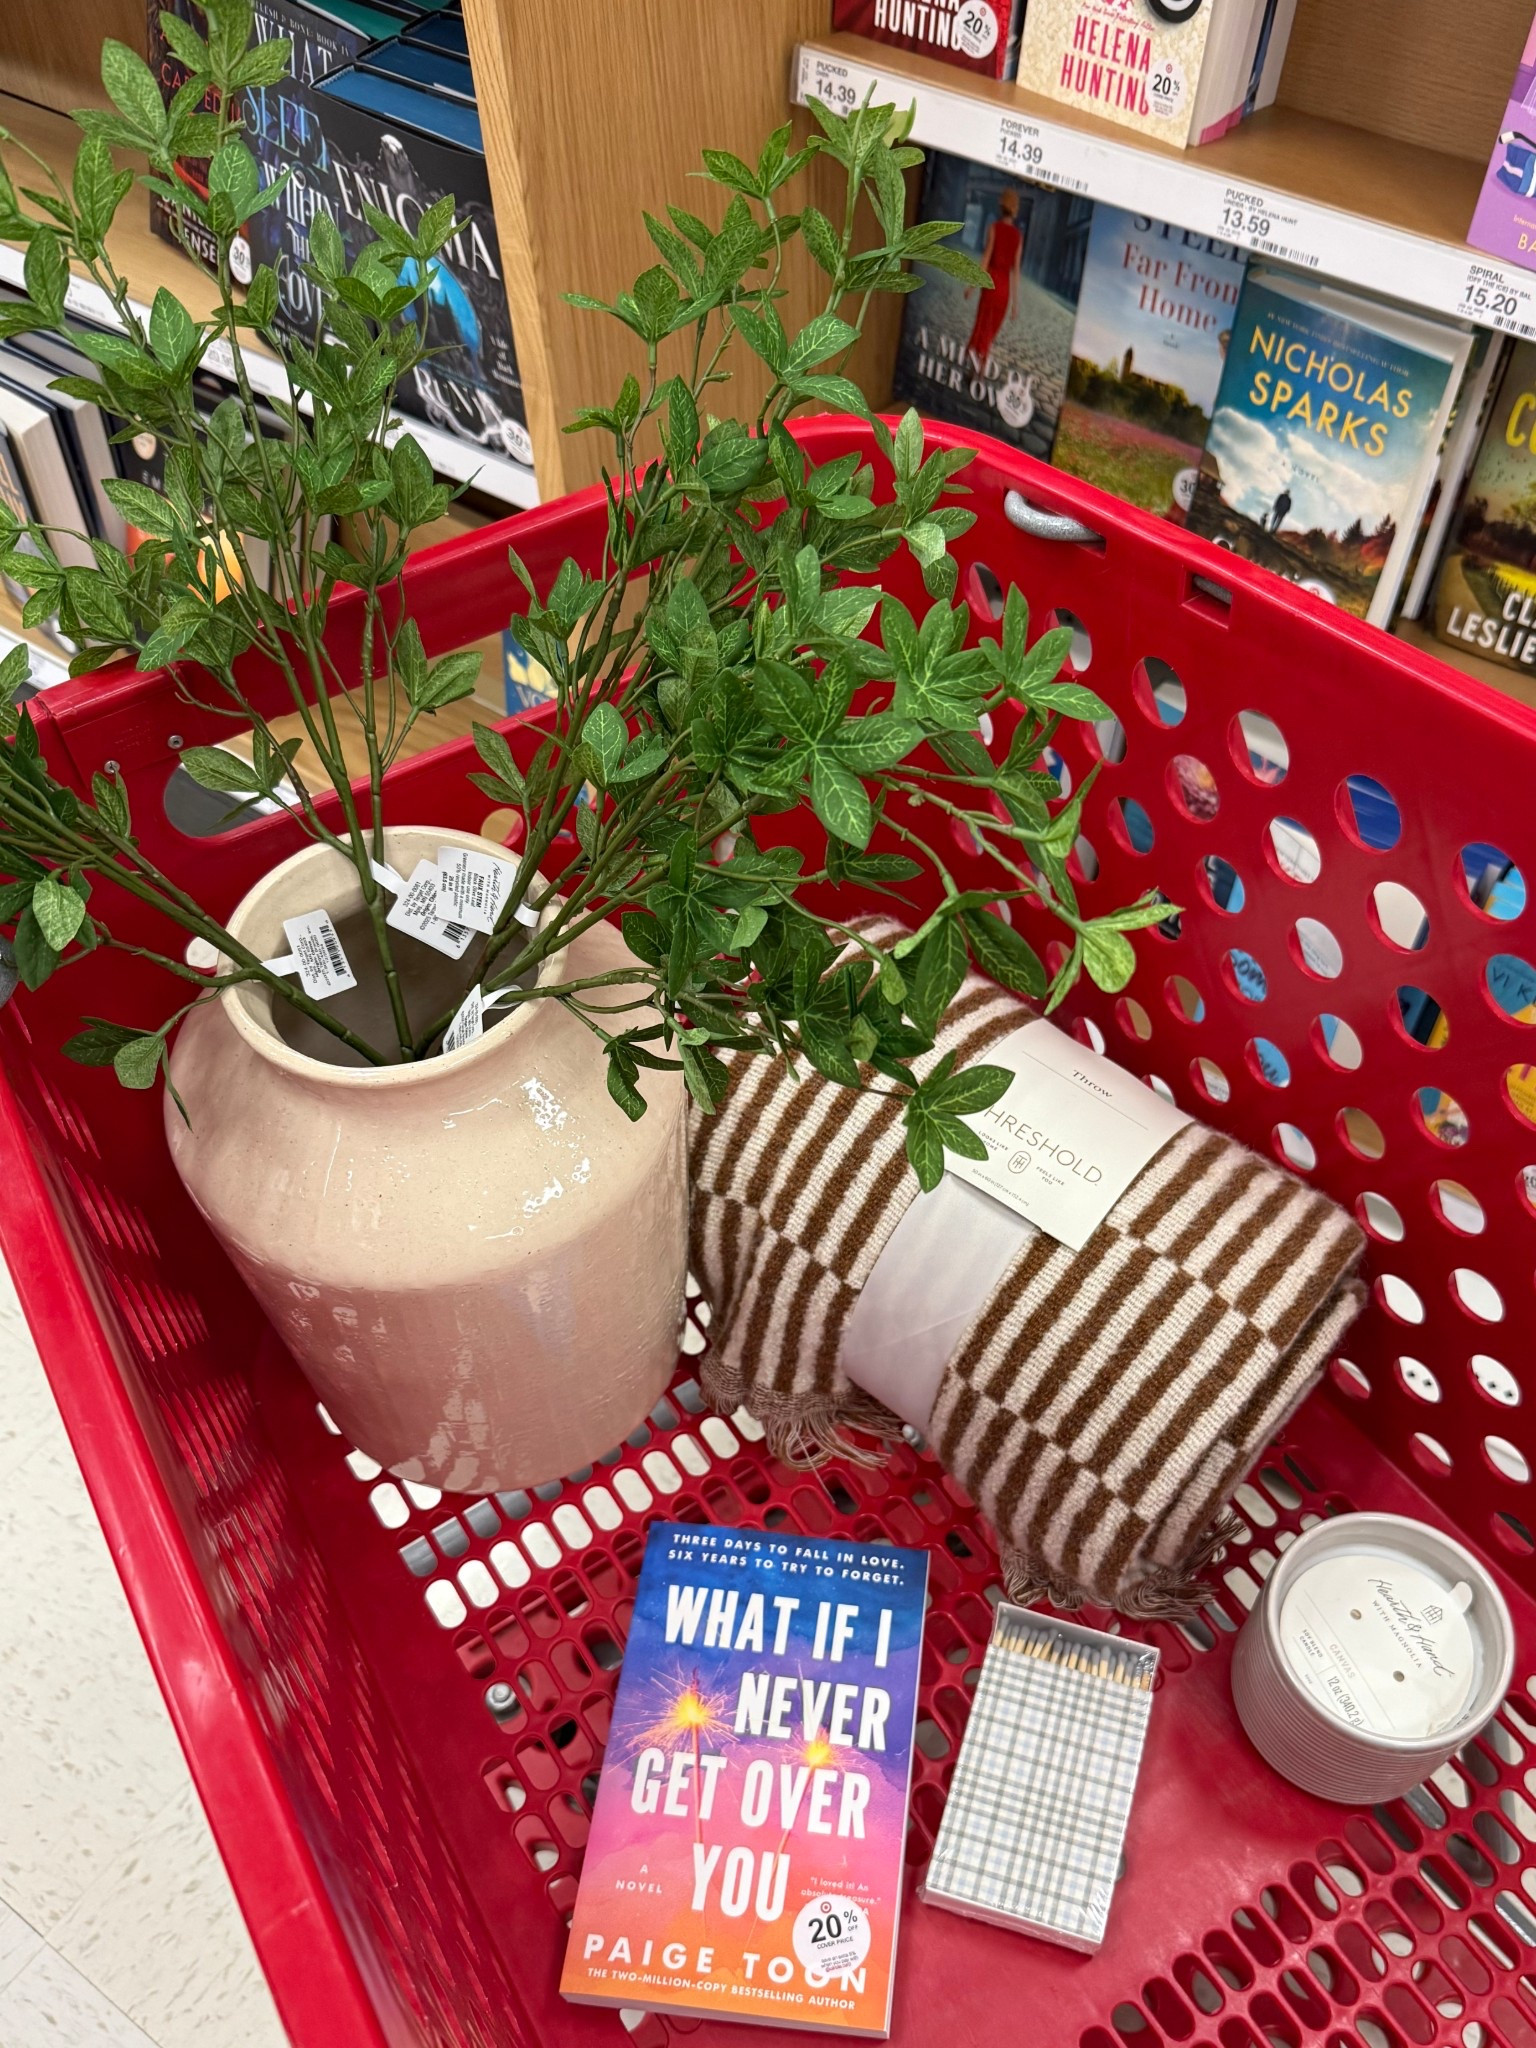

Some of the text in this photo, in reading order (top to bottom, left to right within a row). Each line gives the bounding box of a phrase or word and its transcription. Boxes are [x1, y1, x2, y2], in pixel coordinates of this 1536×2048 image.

[1072, 14, 1151, 74] HELENA
[816, 60, 848, 78] PUCKED
[816, 79, 856, 105] 14.39
[1001, 118, 1040, 138] FOREVER
[1000, 136, 1043, 164] 14.39
[1225, 189, 1264, 208] PUCKED
[1222, 207, 1271, 236] 13.59
[184, 227, 217, 264] ENSE
[1122, 243, 1168, 281] Far
[1469, 265, 1505, 285] SPIRAL
[1138, 284, 1217, 333] Home
[1464, 284, 1518, 316] 15.20
[918, 354, 962, 393] HER
[1249, 324, 1413, 418] NICHOLAS
[1249, 371, 1388, 458] SPARKS
[1447, 605, 1536, 664] LESLIE
[475, 891, 483, 907] STEM
[1072, 1068, 1113, 1099] Throw
[983, 1105, 1103, 1185] HRESHOLD
[668, 1549, 905, 1586] SIX YEARS TO TRY TO FORGET.
[673, 1533, 905, 1570] THREE DAYS TO FALL IN LOVE.
[665, 1584, 893, 1668] WHAT IF I
[1367, 1578, 1453, 1677] Hearth & Hand
[1371, 1600, 1423, 1669] WITH MAGNOLIA
[1329, 1643, 1356, 1679] CANVAS
[1327, 1675, 1338, 1689] 12
[1332, 1685, 1343, 1696] oz
[734, 1672, 892, 1751] NEVER
[1338, 1693, 1360, 1719] (340.2
[631, 1747, 871, 1839] GET OVER
[615, 1880, 663, 1894] NOVEL
[639, 1864, 648, 1874] A
[691, 1842, 791, 1922] YOU
[820, 1877, 843, 1889] loved
[857, 1883, 869, 1892] An
[583, 1933, 715, 1975] PAIGE
[817, 1936, 854, 1950] COVER PRICE
[587, 1967, 856, 2010] THE TWO-MILLION-COPY BESTSELLING AUTHOR
